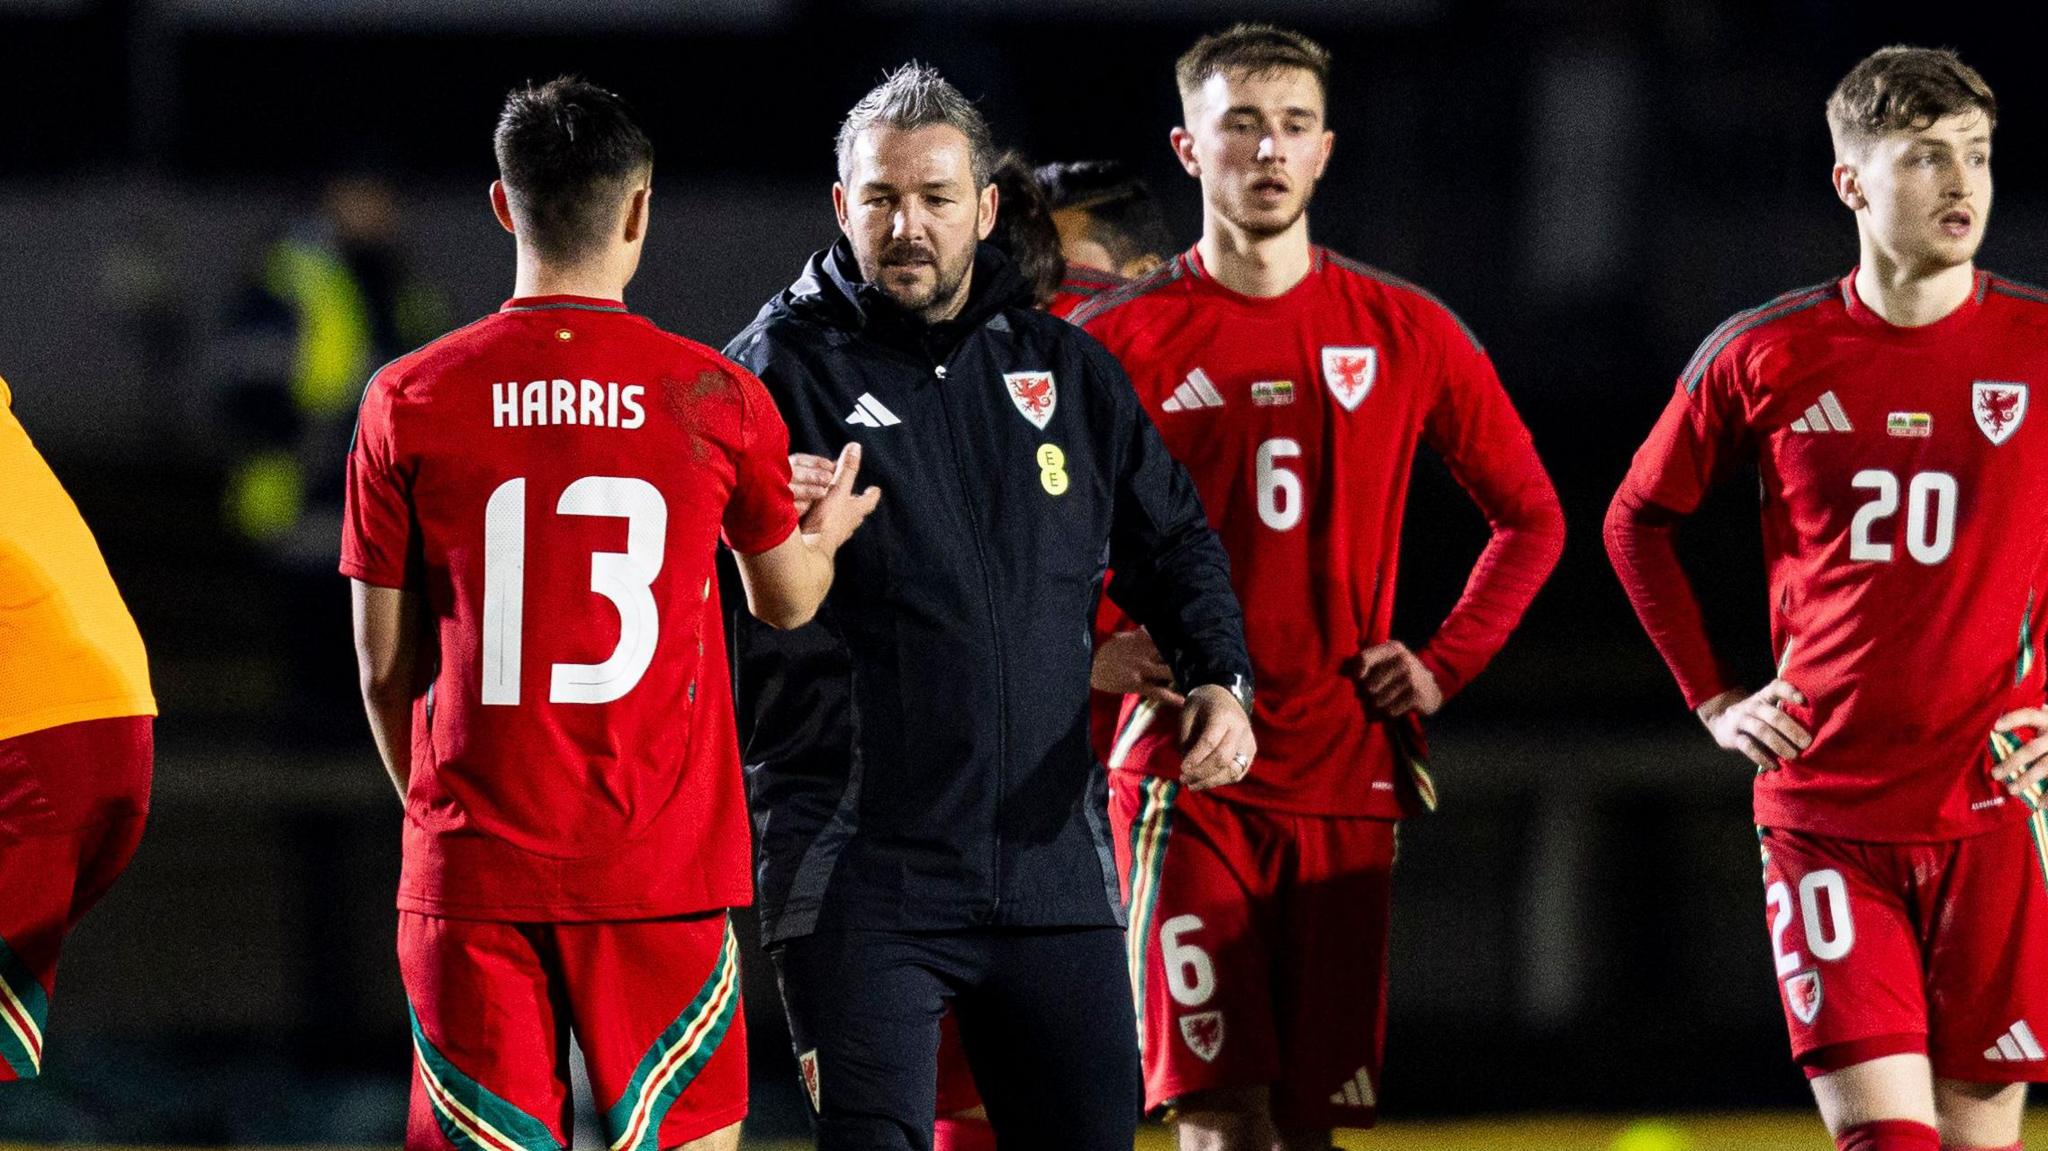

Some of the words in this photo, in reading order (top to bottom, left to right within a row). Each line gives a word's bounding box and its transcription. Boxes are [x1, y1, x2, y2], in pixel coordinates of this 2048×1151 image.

[492, 379, 646, 429] HARRIS
[1257, 438, 1303, 531] 6
[1850, 469, 1957, 565] 20
[481, 476, 668, 705] 13
[1160, 914, 1216, 1007] 6
[1766, 869, 1854, 976] 20
